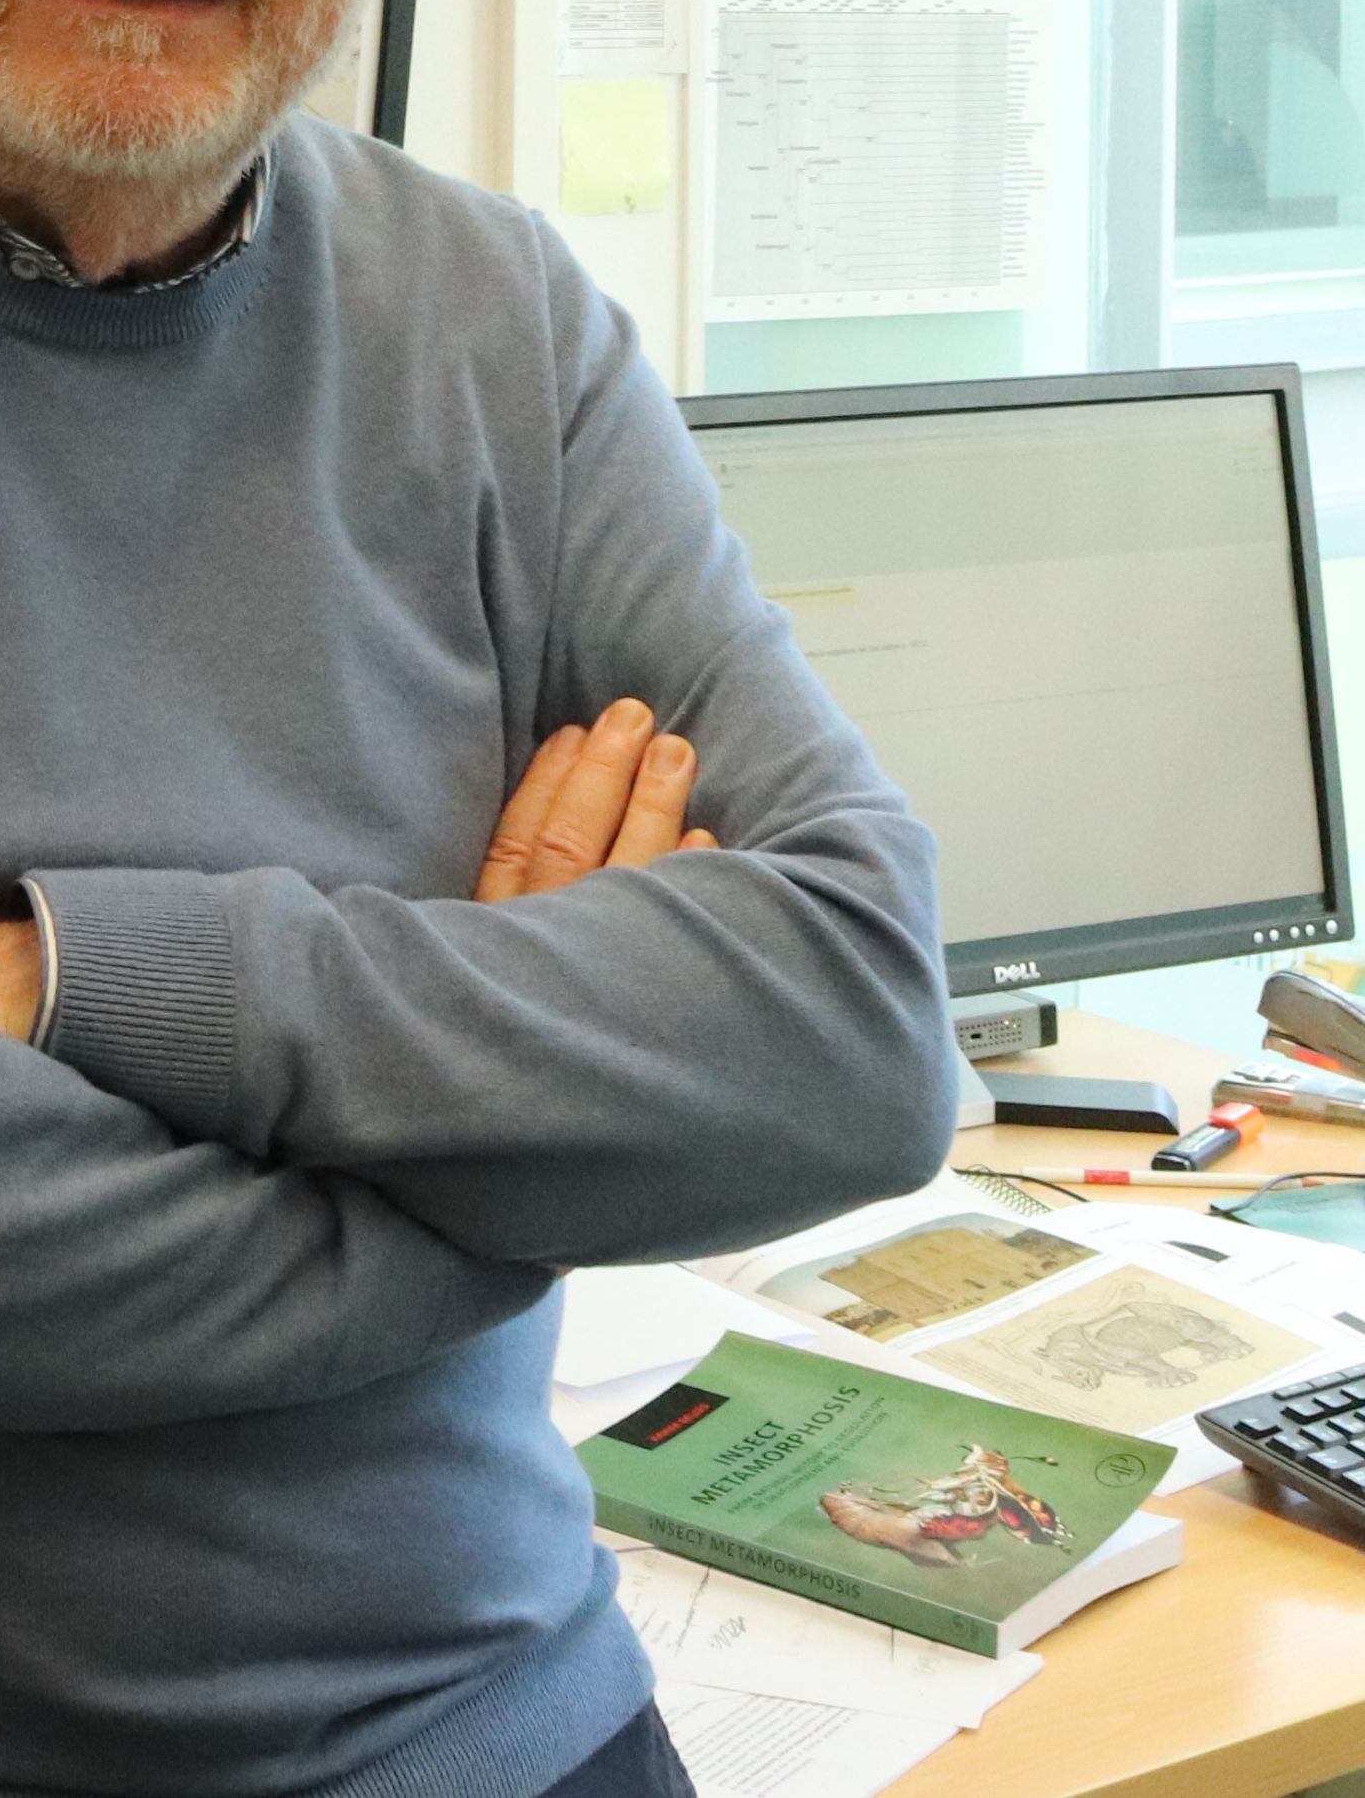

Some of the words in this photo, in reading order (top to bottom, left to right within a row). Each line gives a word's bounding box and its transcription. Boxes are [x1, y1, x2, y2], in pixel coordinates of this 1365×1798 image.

[994, 961, 1041, 984] DELL
[690, 1385, 861, 1507] METAMORPHOSIS
[713, 1419, 786, 1467] INSECT
[648, 1516, 706, 1547] INSECT
[709, 1536, 862, 1599] METAMORPHOSIS
